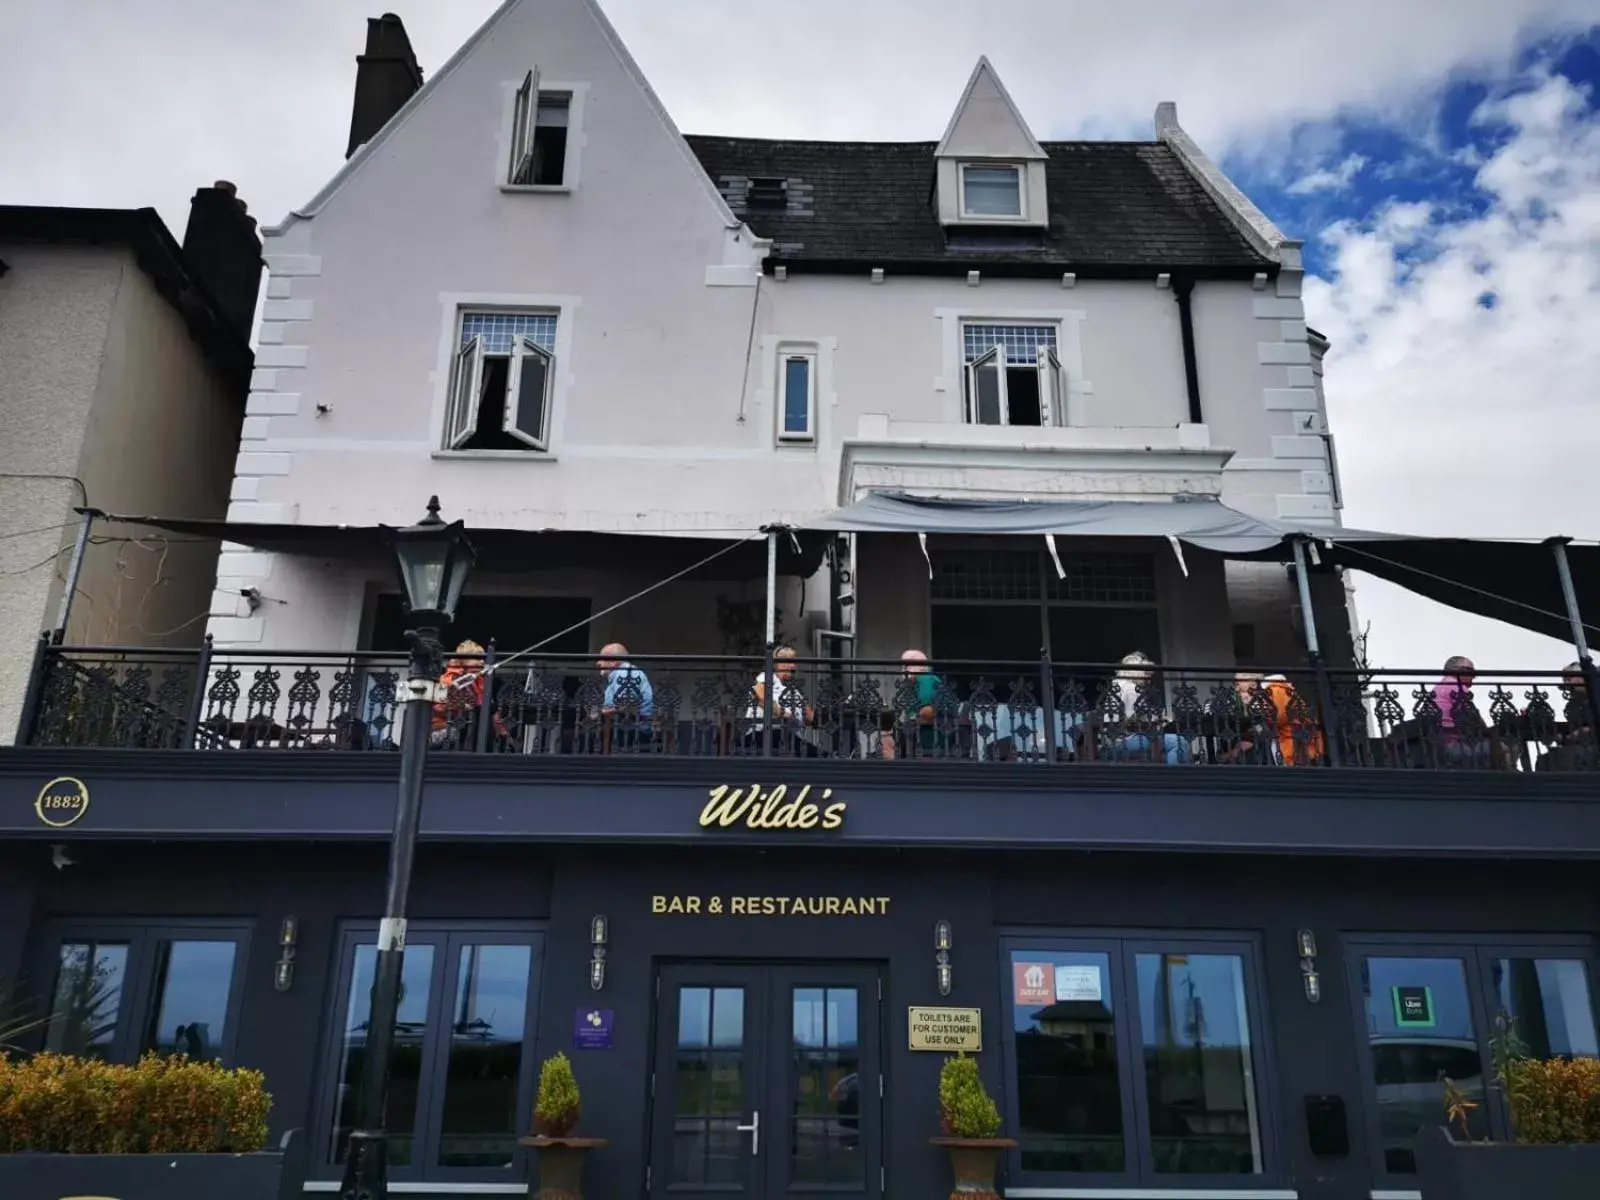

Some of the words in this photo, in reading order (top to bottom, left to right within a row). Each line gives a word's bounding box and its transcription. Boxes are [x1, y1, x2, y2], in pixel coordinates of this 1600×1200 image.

[45, 795, 80, 808] 1882
[699, 784, 846, 828] Wilde's
[652, 896, 700, 913] BAR
[708, 897, 723, 913] &
[731, 897, 890, 914] RESTAURANT
[919, 1013, 952, 1023] TOILETS
[954, 1014, 972, 1023] ARE
[913, 1024, 930, 1033] FOR
[932, 1025, 977, 1034] CUSTOMER
[925, 1035, 942, 1044] USE
[943, 1036, 965, 1044] ONLY
